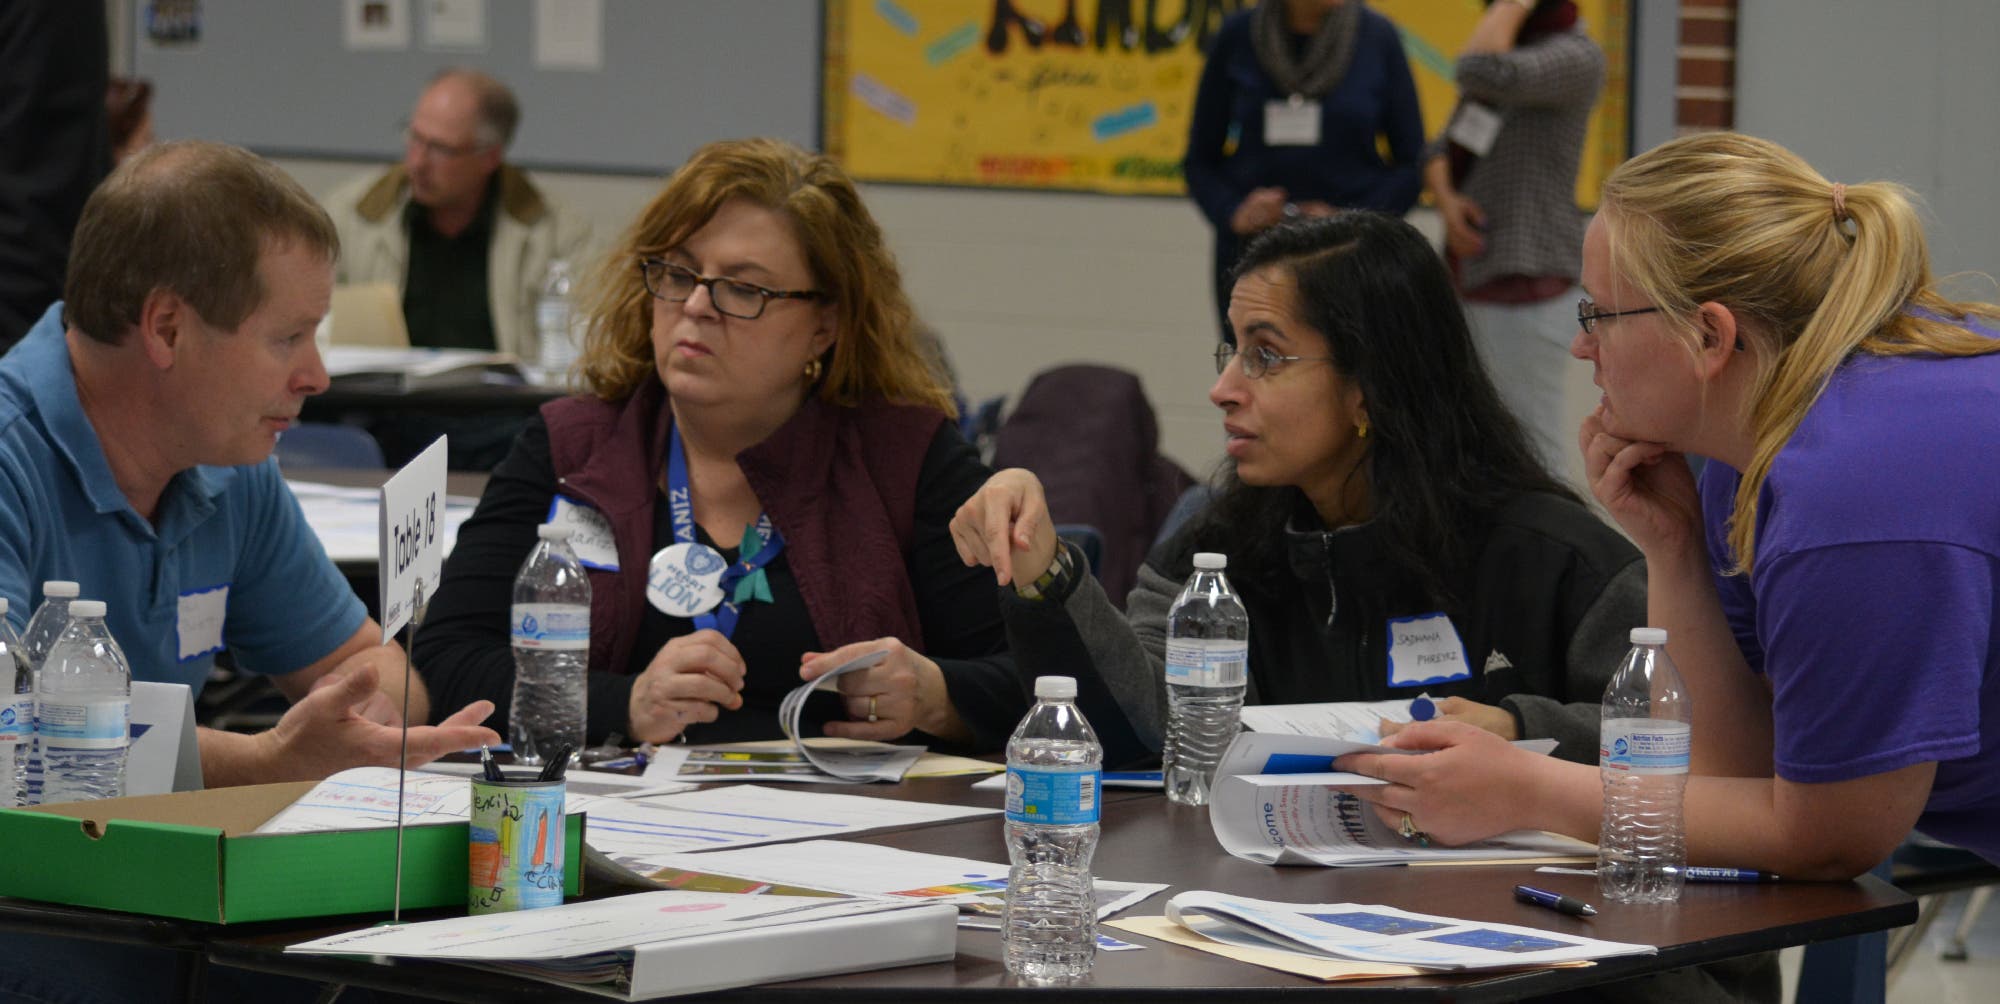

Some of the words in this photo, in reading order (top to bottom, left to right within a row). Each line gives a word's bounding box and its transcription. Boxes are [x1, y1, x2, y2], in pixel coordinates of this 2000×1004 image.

[394, 508, 421, 579] Table
[424, 491, 436, 549] 18
[648, 567, 702, 613] LION
